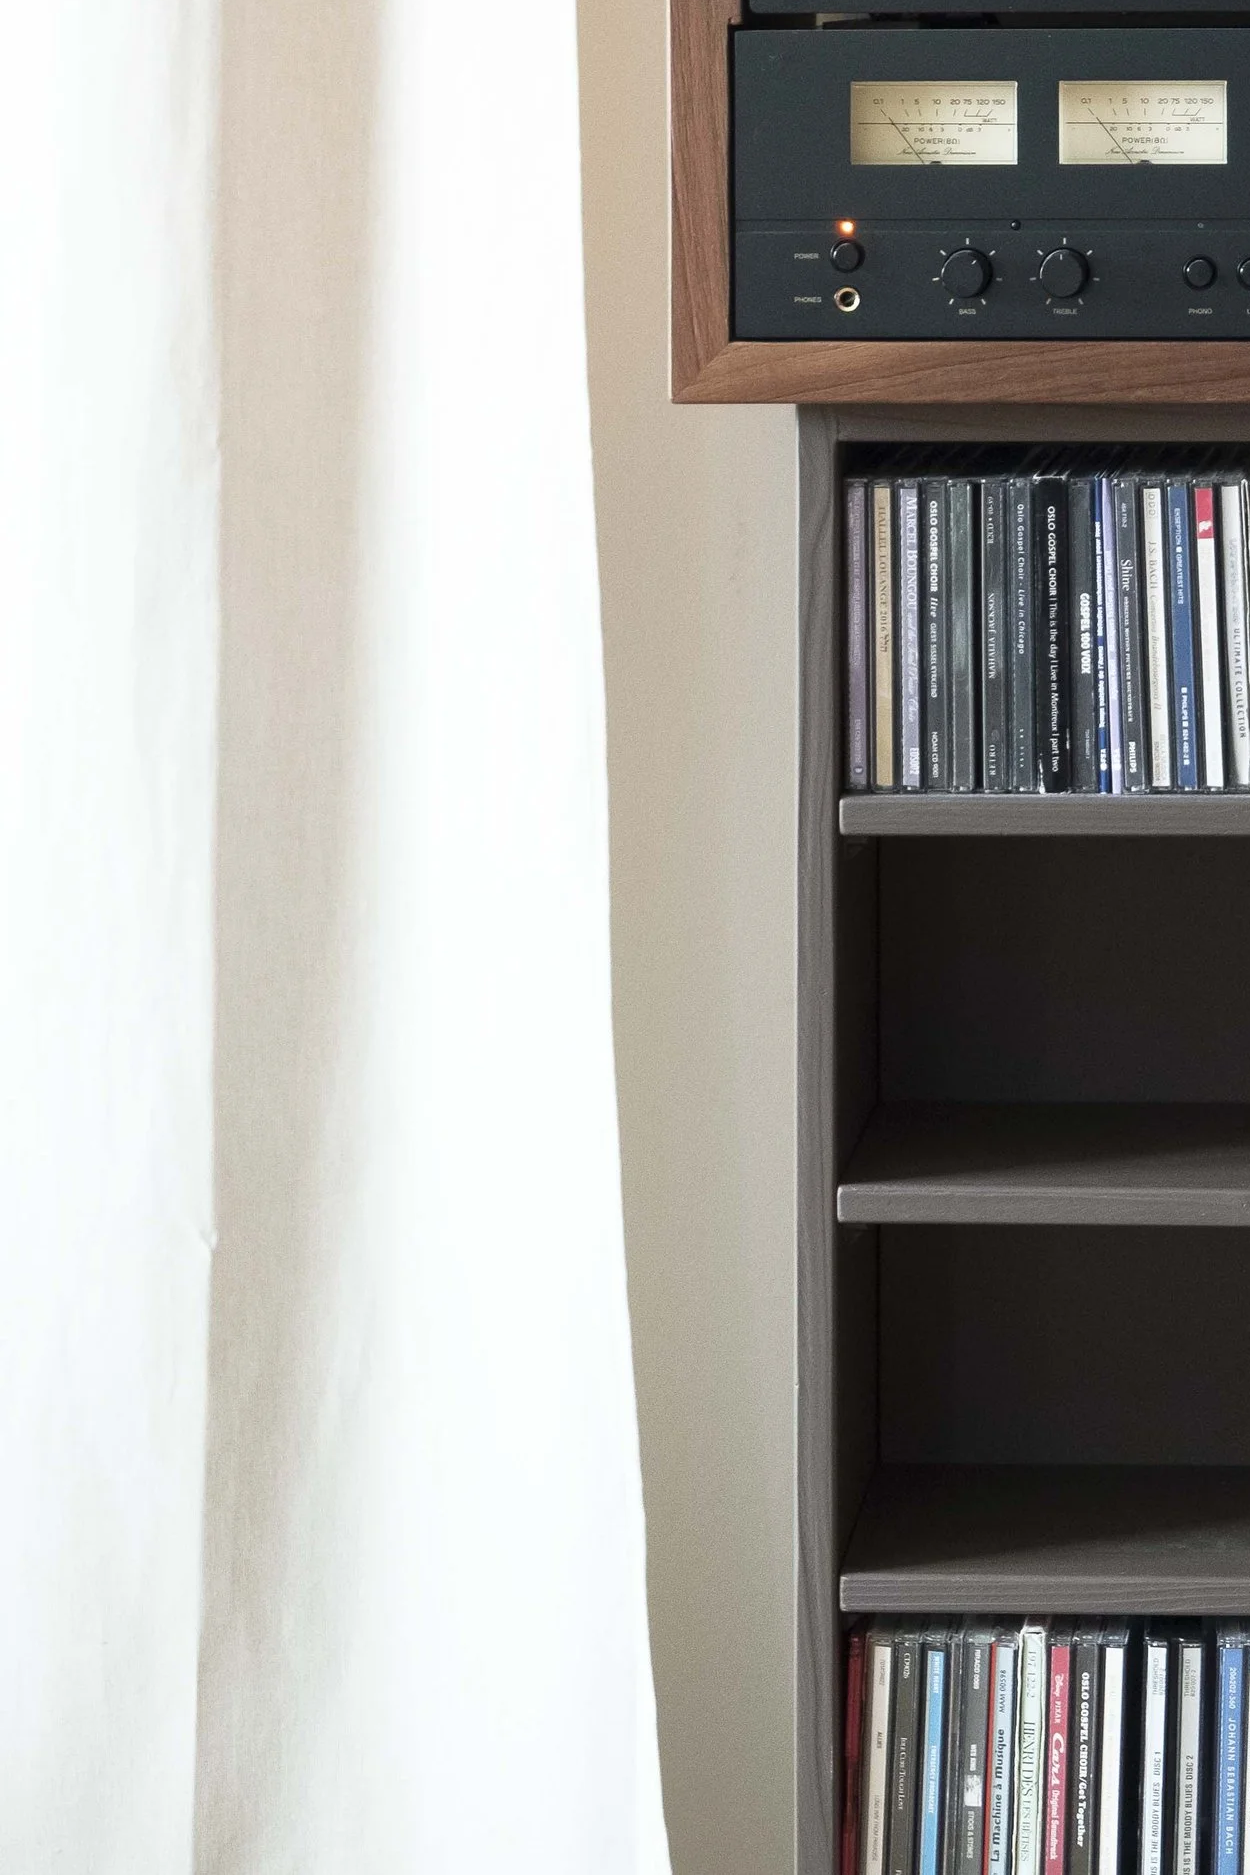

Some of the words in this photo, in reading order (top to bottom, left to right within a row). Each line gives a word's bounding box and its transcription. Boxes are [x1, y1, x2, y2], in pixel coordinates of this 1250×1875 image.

[905, 496, 918, 545] MARCEL
[930, 501, 938, 525] OSLO
[1017, 504, 1025, 522] Oslo
[1047, 506, 1056, 529] OSLO
[879, 507, 888, 552] HALLEL
[930, 527, 938, 561] GOSPEL
[1016, 525, 1025, 554] Gospel
[1047, 533, 1057, 565] GOSPEL
[880, 555, 888, 607] LOUANGE
[906, 549, 918, 609] BOUNGOU
[930, 563, 939, 591] CHOIR
[1017, 557, 1026, 580] Choir
[1048, 568, 1057, 596] CHOIR
[1121, 559, 1133, 591] Shine
[1017, 589, 1026, 606] Live
[1049, 603, 1058, 619] This
[1081, 593, 1090, 630] GOSPEL
[987, 593, 996, 634] JACKSON
[1017, 609, 1026, 618] in
[1016, 621, 1026, 654] Chicago
[1049, 629, 1058, 642] the
[1081, 632, 1090, 649] 100
[988, 638, 996, 678] MAHALIA
[1047, 644, 1059, 658] day
[1082, 650, 1091, 674] VOIX
[1233, 628, 1243, 676] ULTIMATE
[1050, 665, 1059, 681] Live
[1050, 693, 1060, 731] Montreux
[1235, 681, 1246, 739] COLLECTION
[1049, 738, 1060, 754] part
[1129, 742, 1137, 773] PHILIPS
[1051, 757, 1060, 772] two
[999, 1669, 1007, 1692] 00598
[1080, 1672, 1090, 1700] OSLO
[1080, 1701, 1089, 1742] GOSPEL
[995, 1728, 1006, 1779] musique
[1022, 1721, 1036, 1765] HENRI
[1227, 1717, 1236, 1761] JOHANN
[1051, 1732, 1064, 1787] Cars
[1078, 1744, 1089, 1800] CHOIR/Get
[1153, 1758, 1161, 1776] DISC
[1186, 1762, 1194, 1780] DISC
[1021, 1769, 1037, 1797] DÈS
[1152, 1782, 1161, 1807] BLUES
[1185, 1783, 1194, 1808] BLUES
[1226, 1766, 1235, 1821] SEBASTIAN
[1023, 1799, 1034, 1819] LES
[1050, 1789, 1060, 1818] Original
[992, 1794, 1002, 1846] machine
[1076, 1801, 1086, 1848] Together
[1152, 1808, 1161, 1838] MOODY
[1184, 1809, 1193, 1839] MOODY
[1050, 1820, 1060, 1860] Soundtrack
[1151, 1839, 1159, 1854] THE
[1184, 1840, 1192, 1856] THE
[1225, 1826, 1234, 1855] BACH
[991, 1849, 1000, 1862] La
